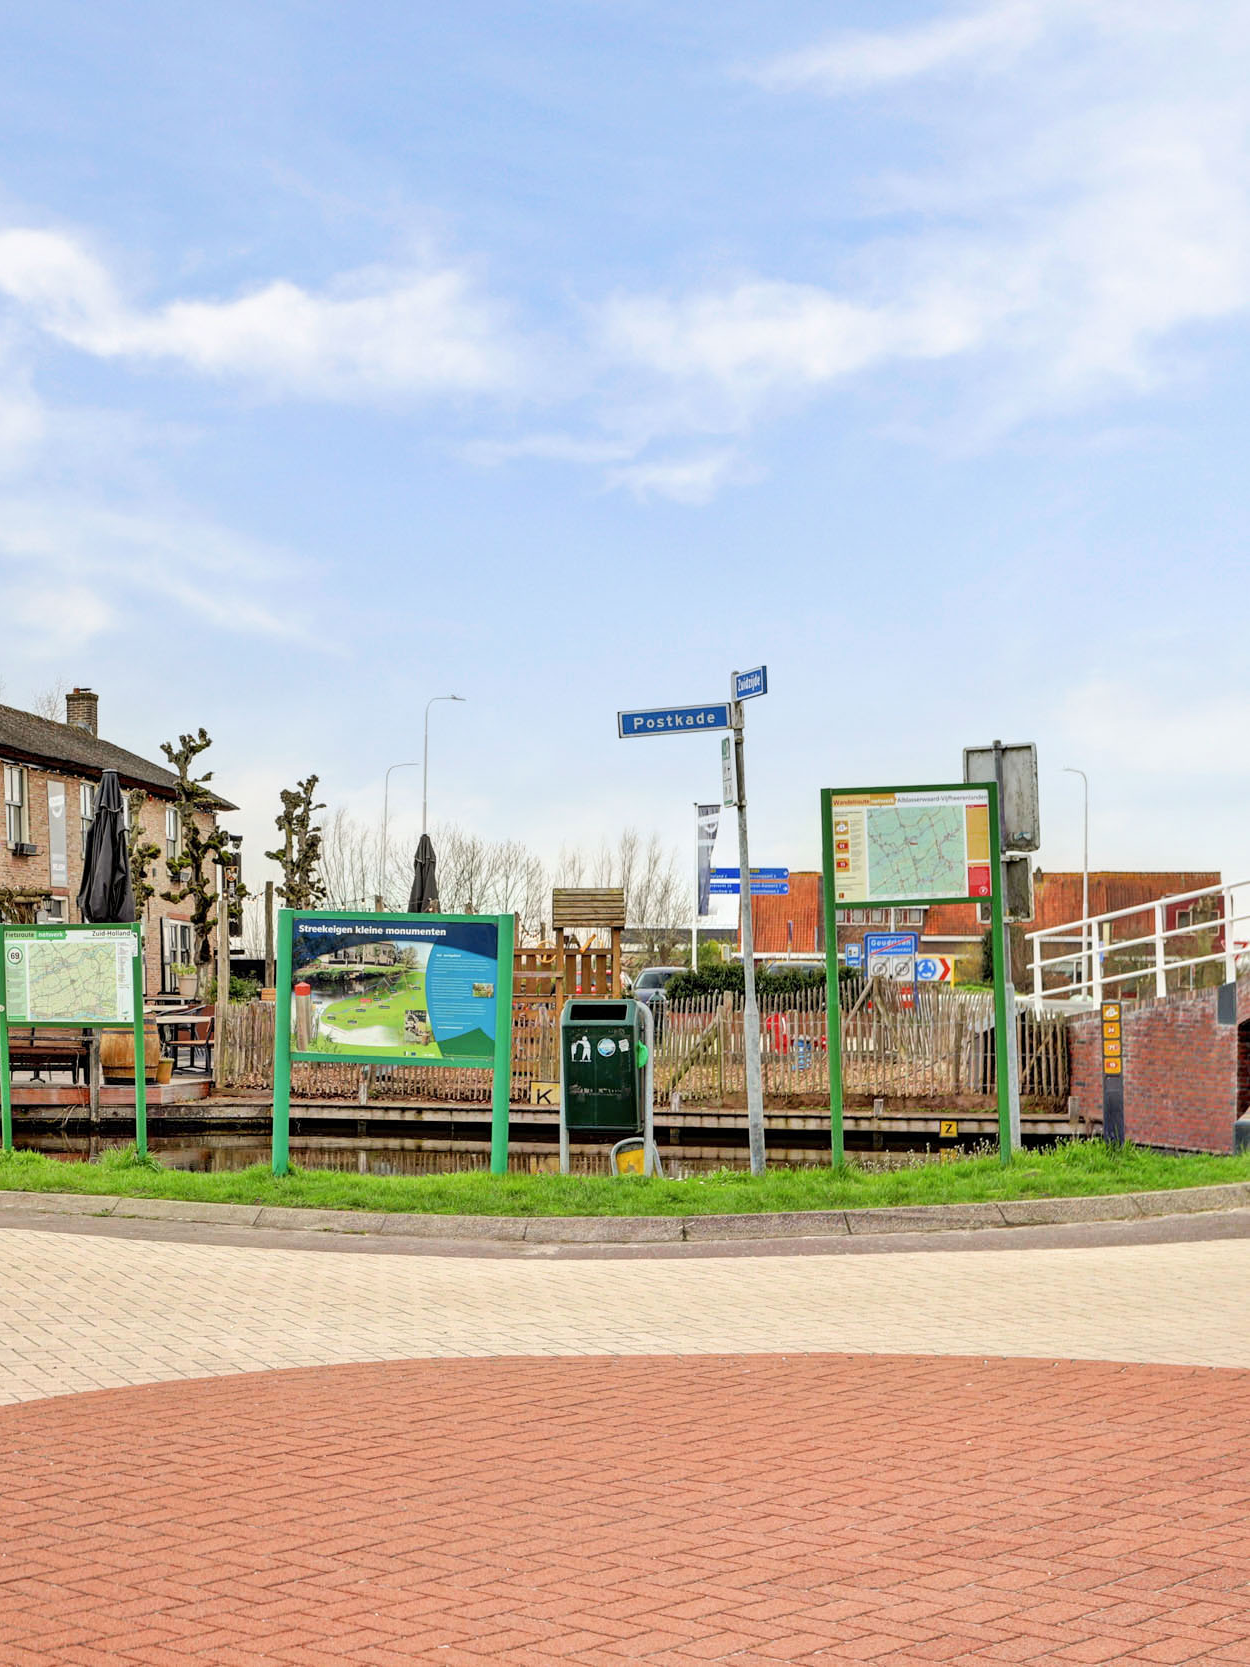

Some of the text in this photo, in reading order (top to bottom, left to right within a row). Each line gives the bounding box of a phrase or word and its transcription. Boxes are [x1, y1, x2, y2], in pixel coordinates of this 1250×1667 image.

[633, 711, 716, 730] Postkade
[298, 925, 447, 936] Streekeigen kleine monumenten
[536, 1088, 553, 1104] K
